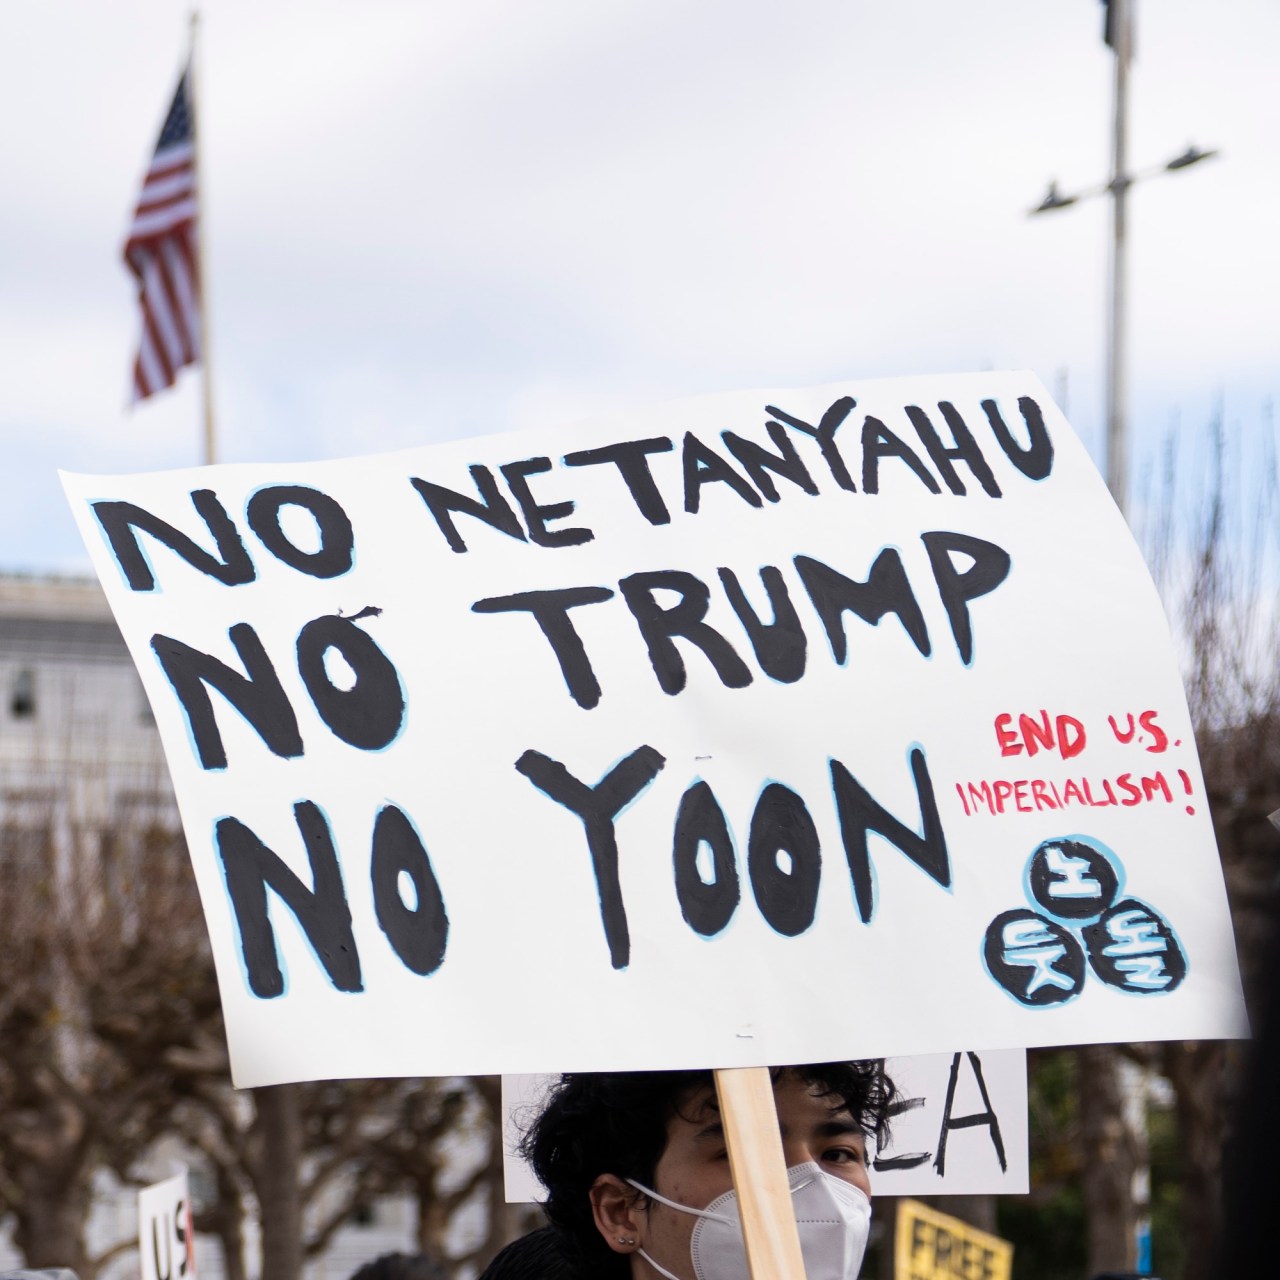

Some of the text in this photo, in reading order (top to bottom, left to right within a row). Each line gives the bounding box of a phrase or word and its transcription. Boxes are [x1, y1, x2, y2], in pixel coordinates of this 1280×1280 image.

[90, 395, 1055, 592] NO NETANYAHU
[150, 530, 1011, 770] NO TRUMP
[994, 709, 1182, 760] END U.S.
[215, 743, 953, 999] NO YOON
[955, 768, 1196, 817] IMPERIALISM!
